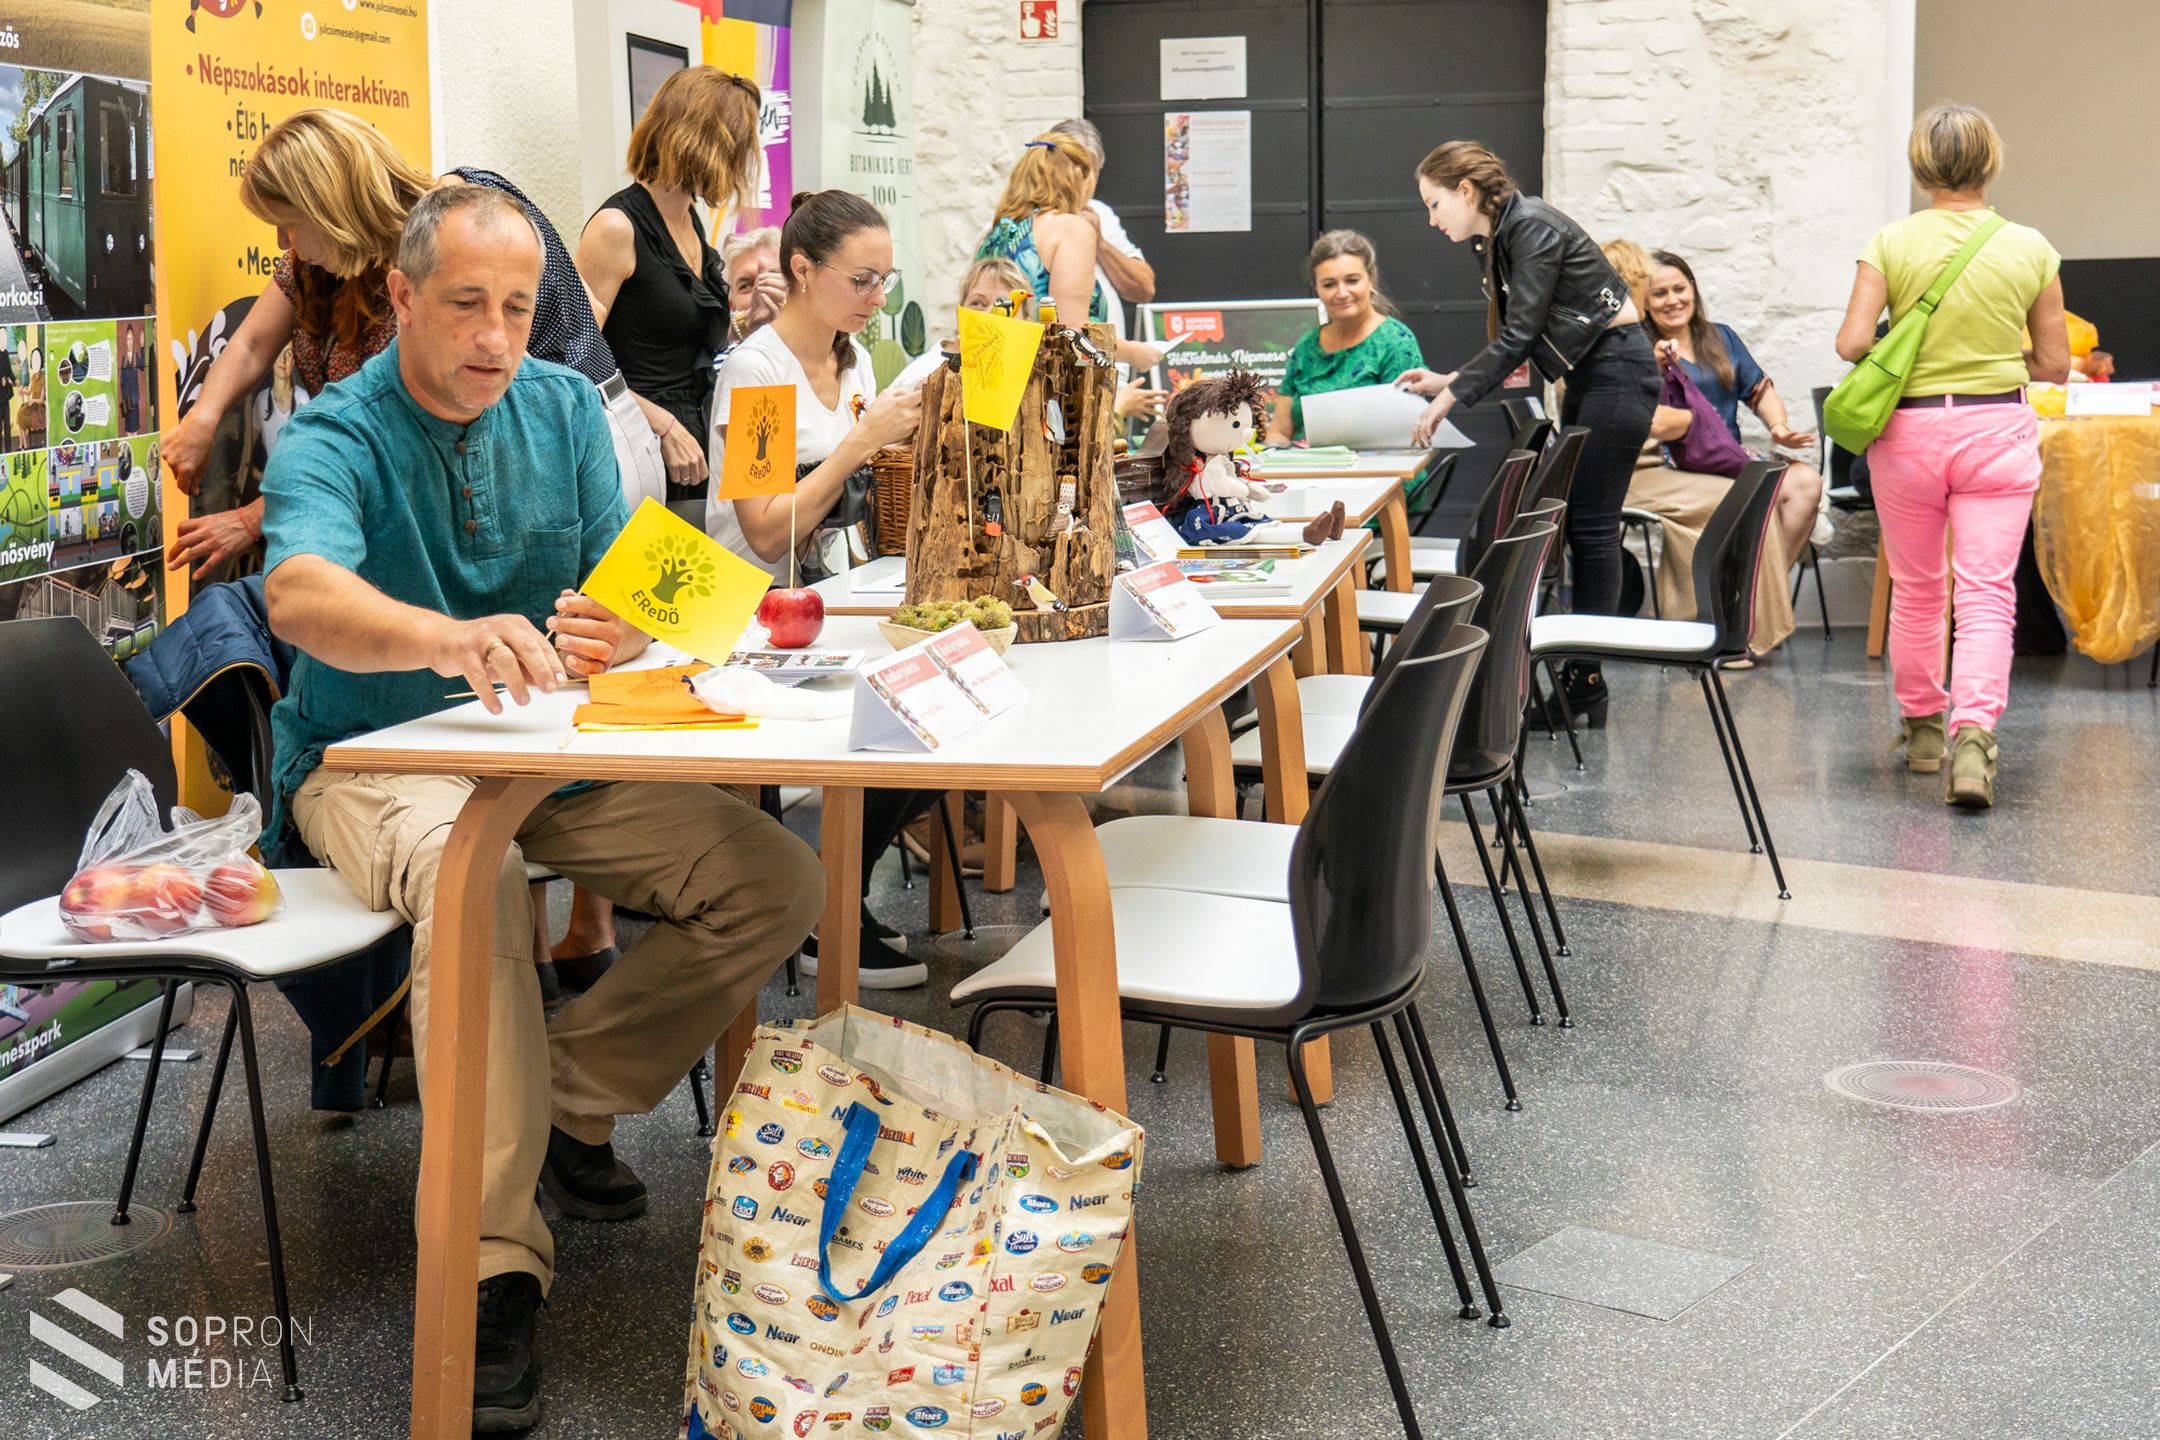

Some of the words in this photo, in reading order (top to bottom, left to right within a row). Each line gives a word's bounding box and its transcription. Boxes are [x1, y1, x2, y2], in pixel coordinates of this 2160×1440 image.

[198, 53, 311, 97] Népszokások
[314, 71, 410, 109] interaktívan
[850, 154, 895, 174] BOTANIKUS
[872, 185, 897, 207] 100
[1, 537, 55, 566] nösvény
[0, 1018, 63, 1068] neszpark
[1026, 1198, 1051, 1209] Blues
[1069, 1194, 1109, 1212] Near
[770, 1205, 811, 1228] Near
[1012, 1230, 1034, 1242] Soft
[1009, 1243, 1035, 1251] Dream
[943, 1286, 967, 1296] Blues
[1050, 1308, 1086, 1325] Near
[765, 1323, 801, 1345] Near
[914, 1410, 942, 1421] Blues
